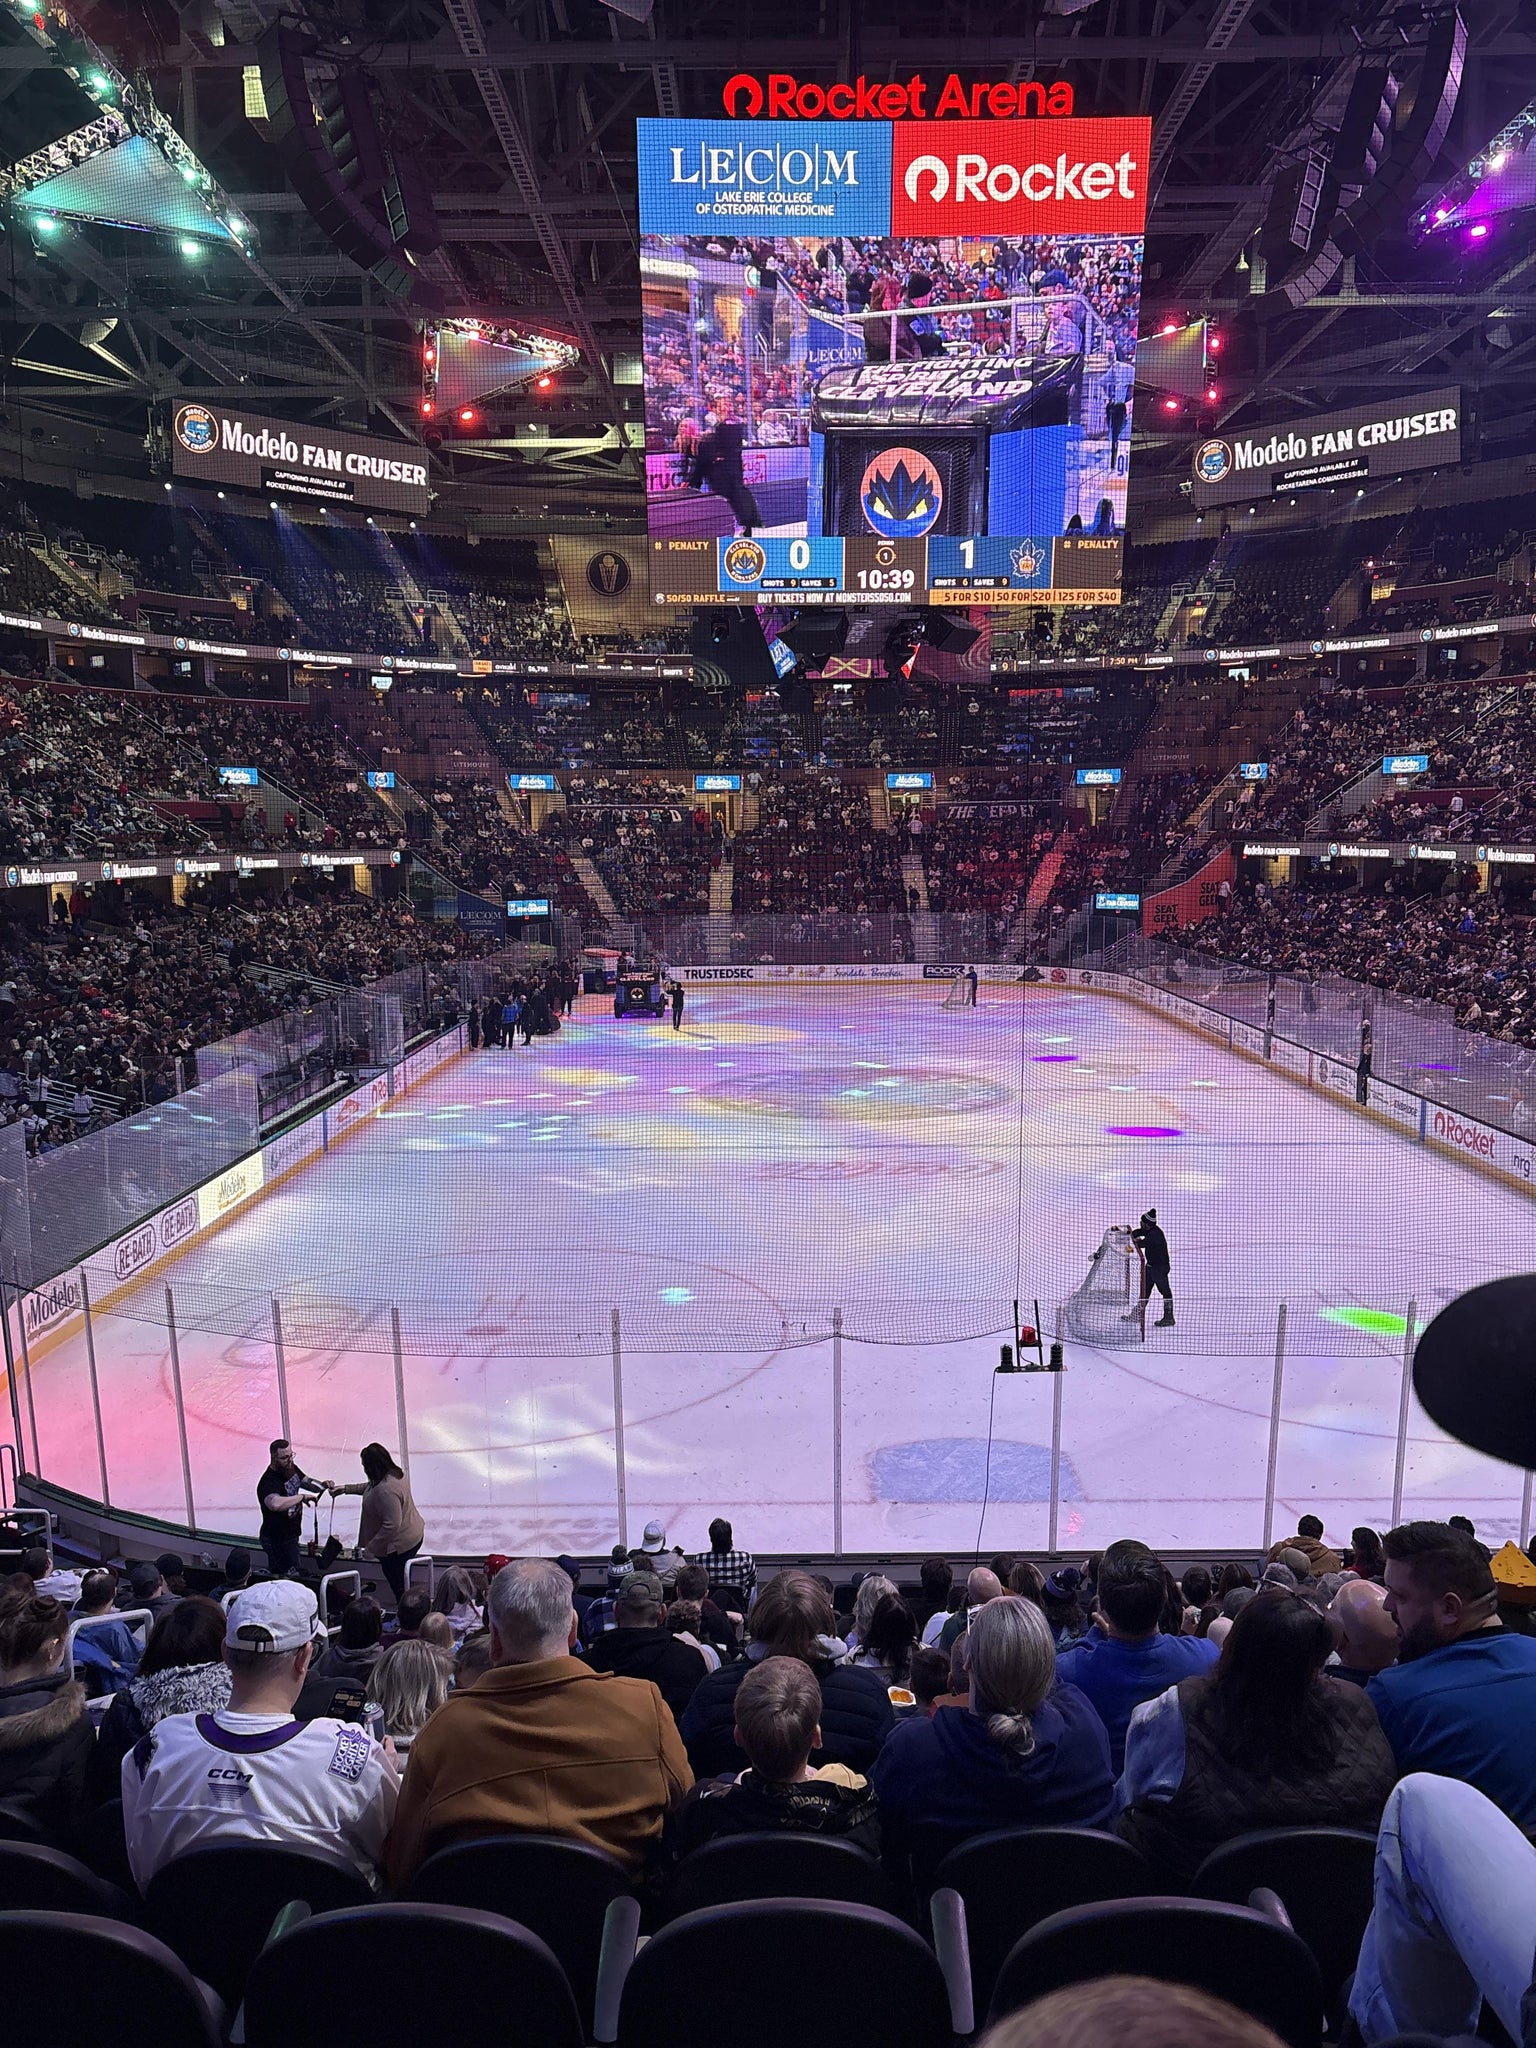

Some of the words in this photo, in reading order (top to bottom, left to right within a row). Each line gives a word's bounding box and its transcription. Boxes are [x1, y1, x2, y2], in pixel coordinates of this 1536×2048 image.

[769, 73, 926, 118] Rocket
[935, 73, 1074, 117] Arena
[956, 151, 1137, 203] Rocket
[714, 190, 742, 204] LAKE
[743, 190, 765, 204] ERIE
[766, 190, 813, 204] COLLEGE
[695, 204, 711, 216] OF
[711, 203, 783, 217] OSTEOPATHIC
[783, 203, 836, 217] MEDICINE
[958, 368, 998, 381] OF
[818, 380, 1034, 400] CLEVELAND
[1234, 432, 1307, 471] Modelo
[1311, 428, 1354, 457] FAN
[1357, 408, 1457, 447] CRUISER
[222, 418, 299, 464] Modelo
[302, 444, 342, 472] FAN
[345, 453, 427, 486] CRUISER
[1284, 466, 1319, 479] CAPTIONING
[1319, 461, 1350, 473] AVAILABLE
[1350, 458, 1359, 467] AT
[275, 470, 309, 483] CAPTIONING
[309, 476, 338, 489] AVAILABLE
[338, 481, 346, 489] AT
[654, 541, 663, 550] #
[668, 541, 710, 551] PENALTY
[1063, 540, 1071, 549] #
[1077, 539, 1119, 550] PENALTY
[789, 539, 811, 570] 0
[883, 552, 888, 560] 1
[960, 539, 975, 570] 1
[762, 579, 785, 587] SHOTS
[790, 578, 797, 587] 9
[801, 579, 822, 587] SAVES
[828, 578, 835, 587] 5
[857, 569, 915, 590] 10:39
[934, 578, 957, 587] SHOTS
[962, 578, 969, 587] 6
[973, 578, 995, 587] SAVES
[1001, 578, 1008, 587] 9
[666, 594, 692, 604] 50/50
[693, 593, 726, 603] RAFFLE
[757, 593, 771, 603] BUY
[772, 592, 805, 604] TICKETS
[806, 593, 823, 603] NOW
[824, 593, 834, 603] AT
[944, 592, 951, 602] 5
[953, 592, 971, 602] FOR
[973, 592, 990, 602] $10
[997, 592, 1010, 602] 50
[1011, 592, 1030, 602] FOR
[1032, 592, 1051, 602] $20
[1058, 592, 1075, 602] 125
[1076, 592, 1096, 602] FOR
[1097, 592, 1117, 602] $40
[1435, 629, 1459, 640] Modelo
[1325, 641, 1350, 652] Modelo
[1219, 648, 1244, 660] Modelo
[1002, 662, 1009, 671] 9
[1109, 657, 1126, 666] 7:50
[662, 668, 683, 676] SHOTS
[947, 804, 978, 819] THE
[1200, 882, 1220, 895] SEAT
[1154, 904, 1178, 914] SEAT
[1153, 914, 1179, 923] GEEK
[683, 968, 755, 980] TRUSTEDSEC
[1446, 1114, 1496, 1159] Rocket
[1513, 1153, 1531, 1178] nrg
[117, 1231, 152, 1274] RE-BATH
[30, 1281, 76, 1326] Modelo
[331, 1735, 351, 1773] HOCKEY
[341, 1741, 361, 1778] FIGHTS
[350, 1741, 369, 1780] CANCER
[207, 1767, 254, 1783] CCM
